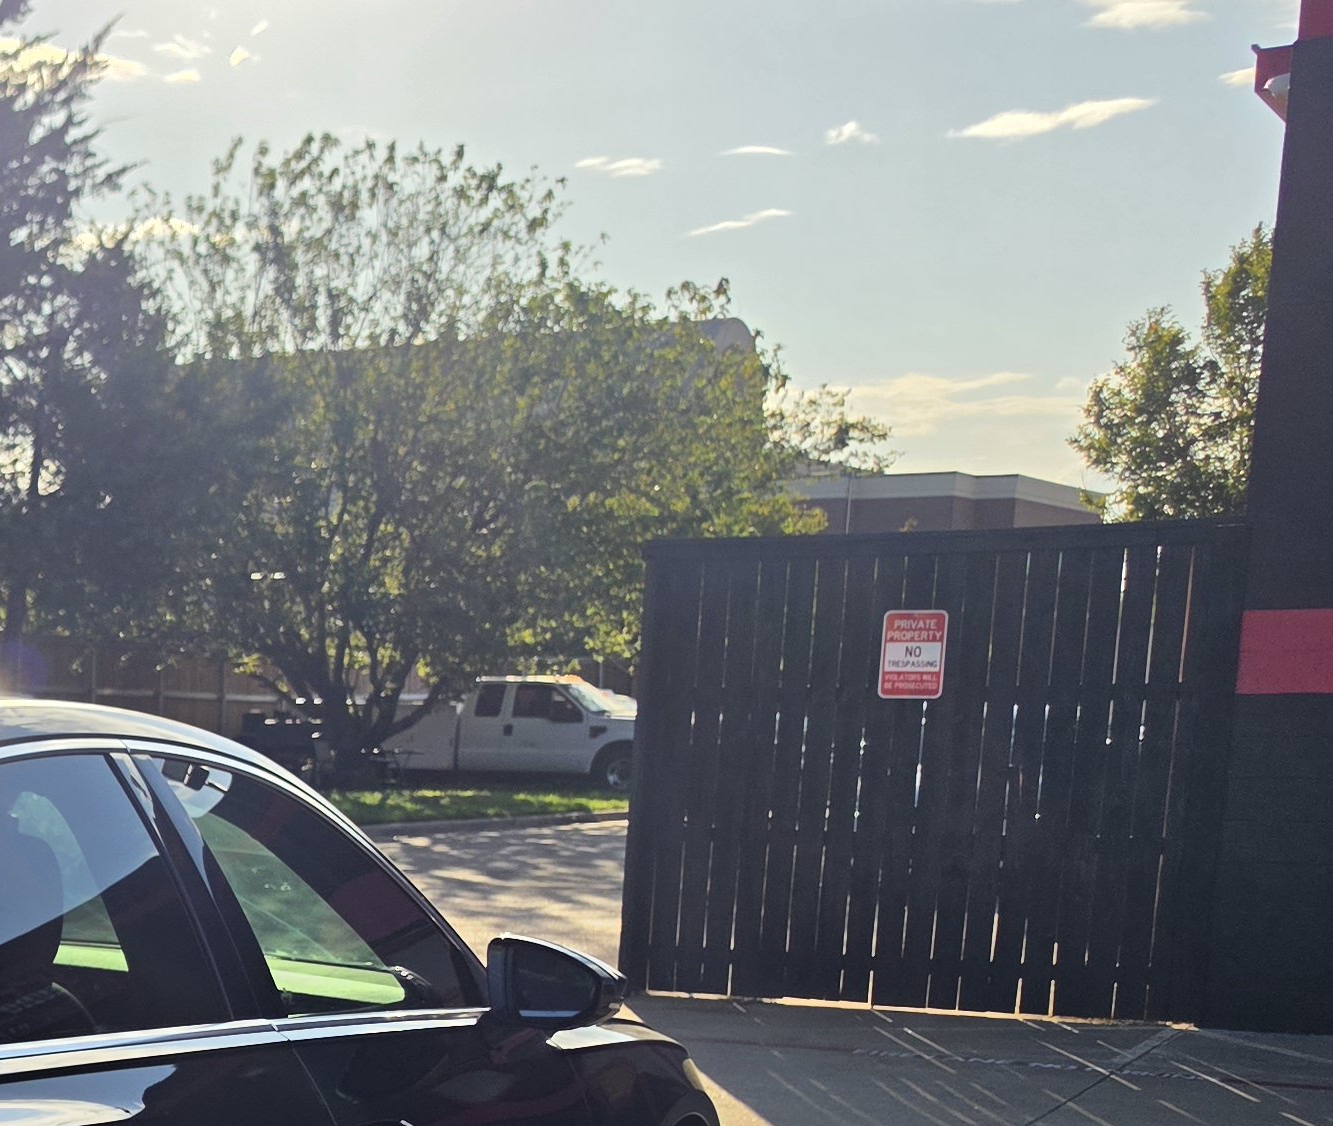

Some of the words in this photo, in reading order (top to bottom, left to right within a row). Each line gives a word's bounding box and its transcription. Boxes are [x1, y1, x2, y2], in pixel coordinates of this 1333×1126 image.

[893, 619, 938, 630] PRIVATE
[886, 630, 942, 641] PROPERTY
[904, 645, 922, 658] NO
[887, 660, 938, 668] TRESPASSING
[884, 673, 921, 681] VIOLATORS
[922, 673, 937, 681] WILL
